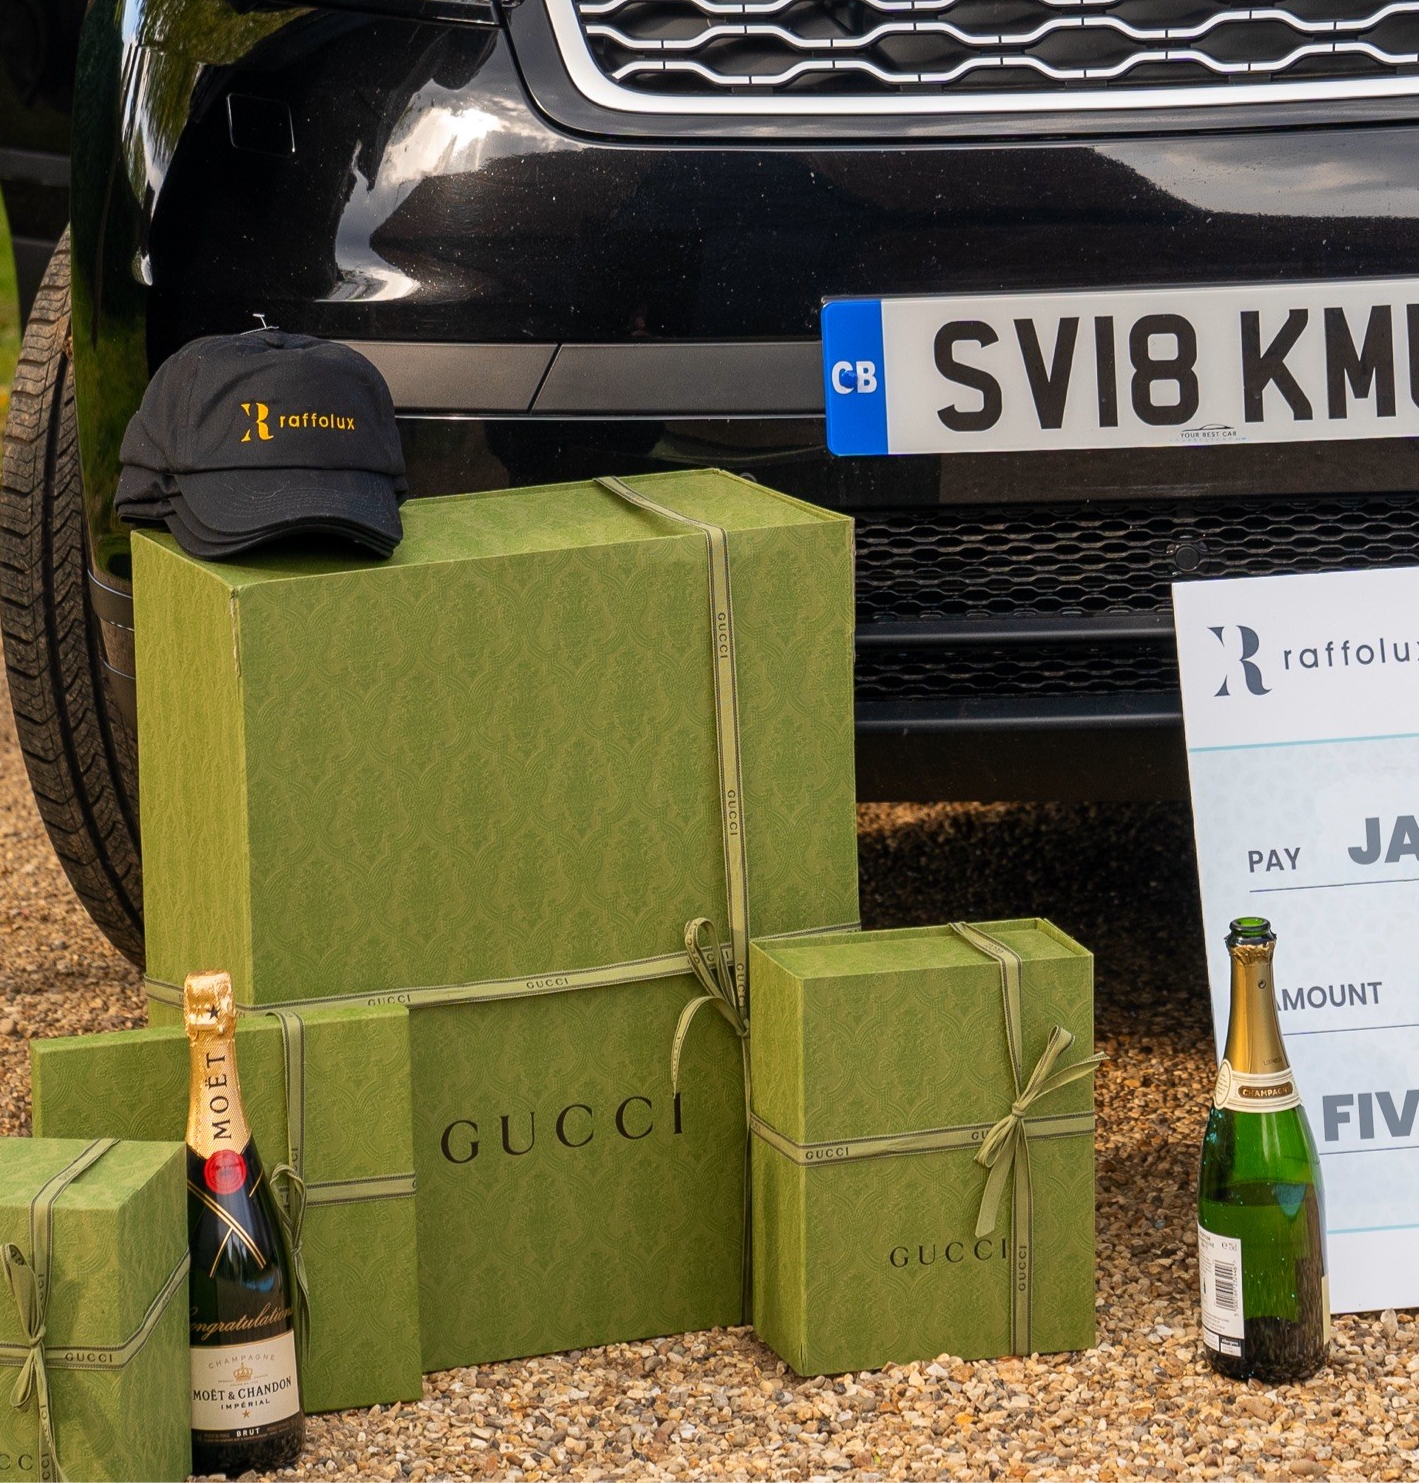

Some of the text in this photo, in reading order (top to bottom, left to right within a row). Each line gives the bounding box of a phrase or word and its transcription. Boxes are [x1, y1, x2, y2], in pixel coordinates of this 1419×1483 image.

[933, 313, 1200, 432] SV18
[279, 412, 355, 430] raffolux
[717, 612, 727, 659] GUCCI
[727, 789, 737, 836] GUCCI
[1248, 847, 1301, 873] PAY
[526, 977, 569, 990] GUCCI
[368, 994, 411, 1006] GUCCI
[205, 1052, 231, 1140] MOËT
[440, 1092, 683, 1164] GUCCI
[805, 1146, 850, 1161] GUCCI
[889, 1238, 1007, 1268] GUCCI
[1018, 1245, 1027, 1292] GUCCI
[190, 1302, 292, 1340] ongratulation
[65, 1352, 113, 1363] GUCCI
[208, 1354, 275, 1370] CHAMPAGNE
[193, 1388, 226, 1401] MOËT
[228, 1391, 235, 1400] &
[238, 1376, 292, 1400] CHANDON
[221, 1398, 271, 1410] IMPÉRIAL
[236, 1427, 261, 1438] BRUT
